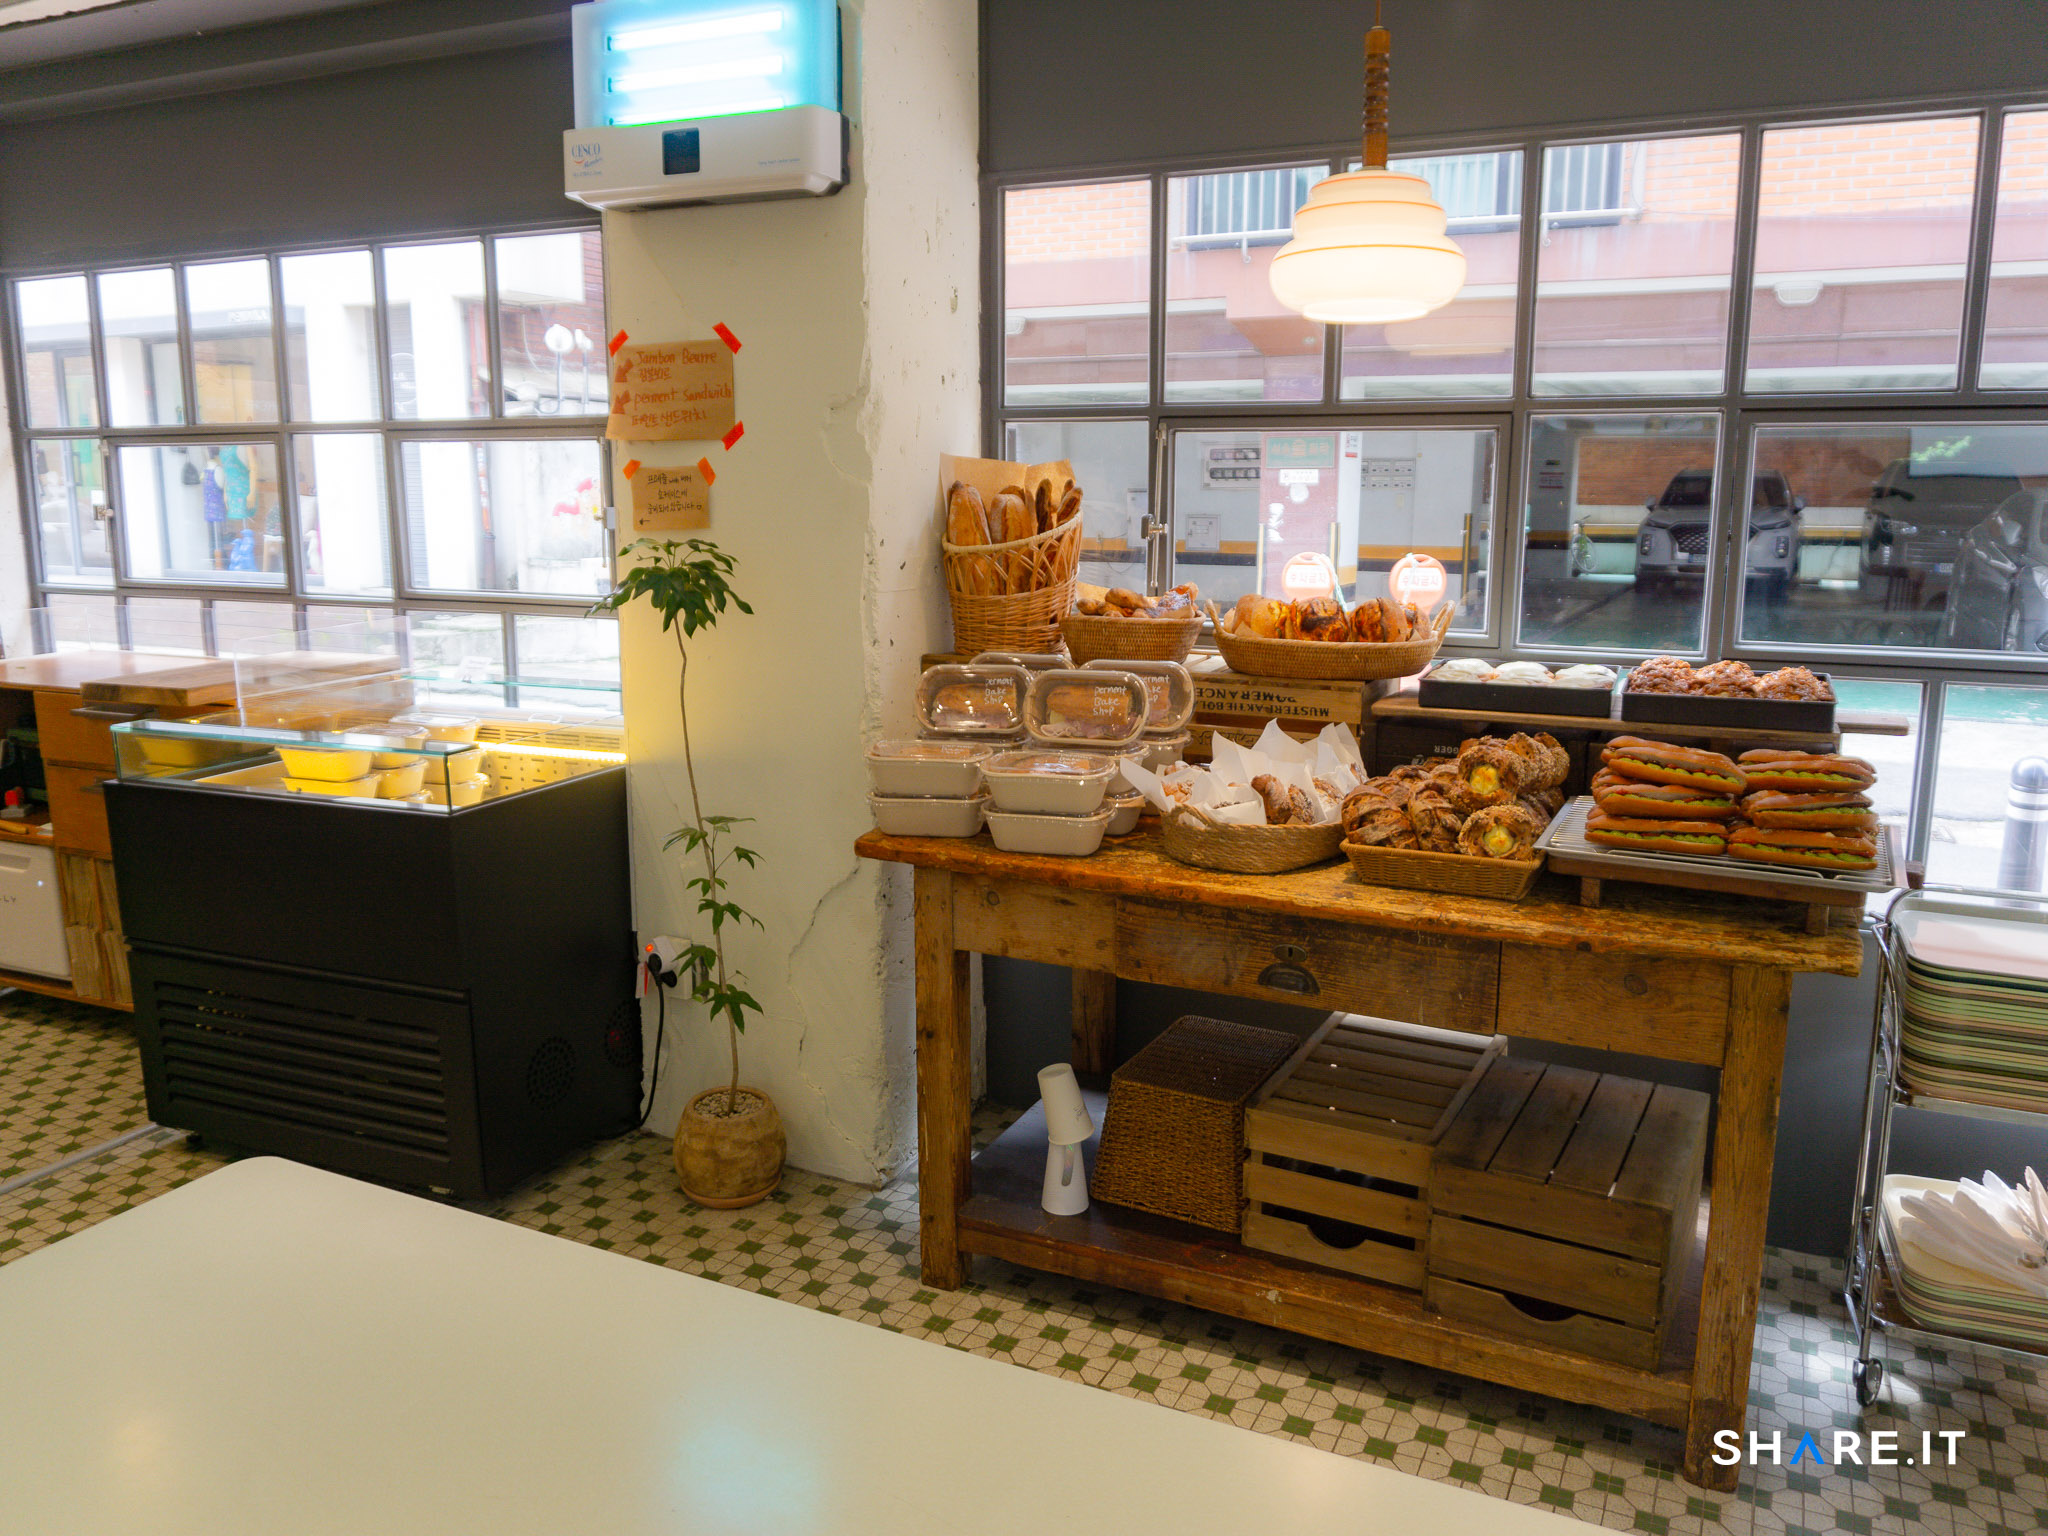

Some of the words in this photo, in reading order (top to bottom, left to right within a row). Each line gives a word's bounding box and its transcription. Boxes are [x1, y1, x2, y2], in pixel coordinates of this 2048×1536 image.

[571, 143, 601, 157] CESCO
[636, 350, 675, 365] Jambon
[682, 348, 717, 365] Beurre
[683, 382, 732, 401] Sandwich
[1141, 675, 1170, 684] erment
